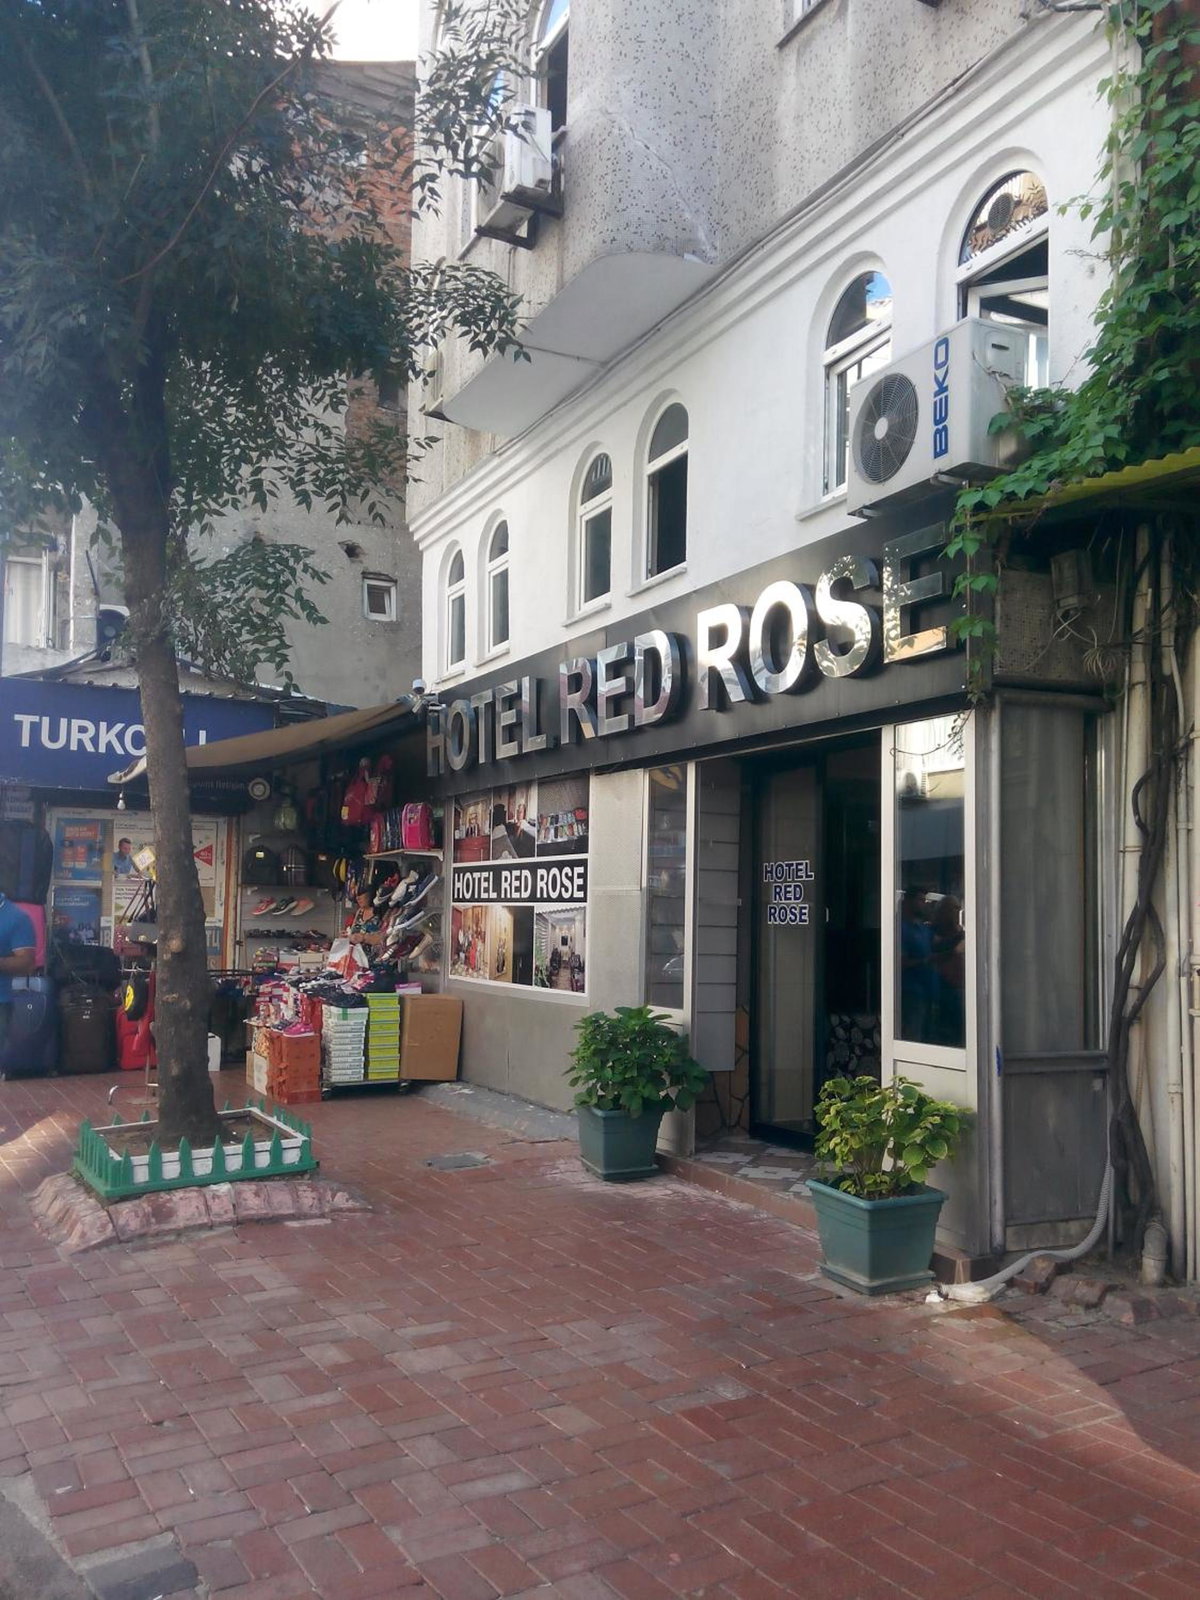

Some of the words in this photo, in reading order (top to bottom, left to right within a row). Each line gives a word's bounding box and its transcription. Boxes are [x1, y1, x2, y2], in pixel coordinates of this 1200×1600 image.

[933, 336, 949, 459] BEKO
[427, 675, 547, 777] HOTEL
[559, 629, 678, 745] RED
[697, 521, 947, 710] ROSE
[454, 871, 497, 899] HOTEL
[501, 869, 532, 899] RED
[536, 866, 585, 899] ROSE
[763, 860, 814, 882] HOTEL
[773, 883, 803, 903] RED
[768, 904, 809, 924] ROSE
